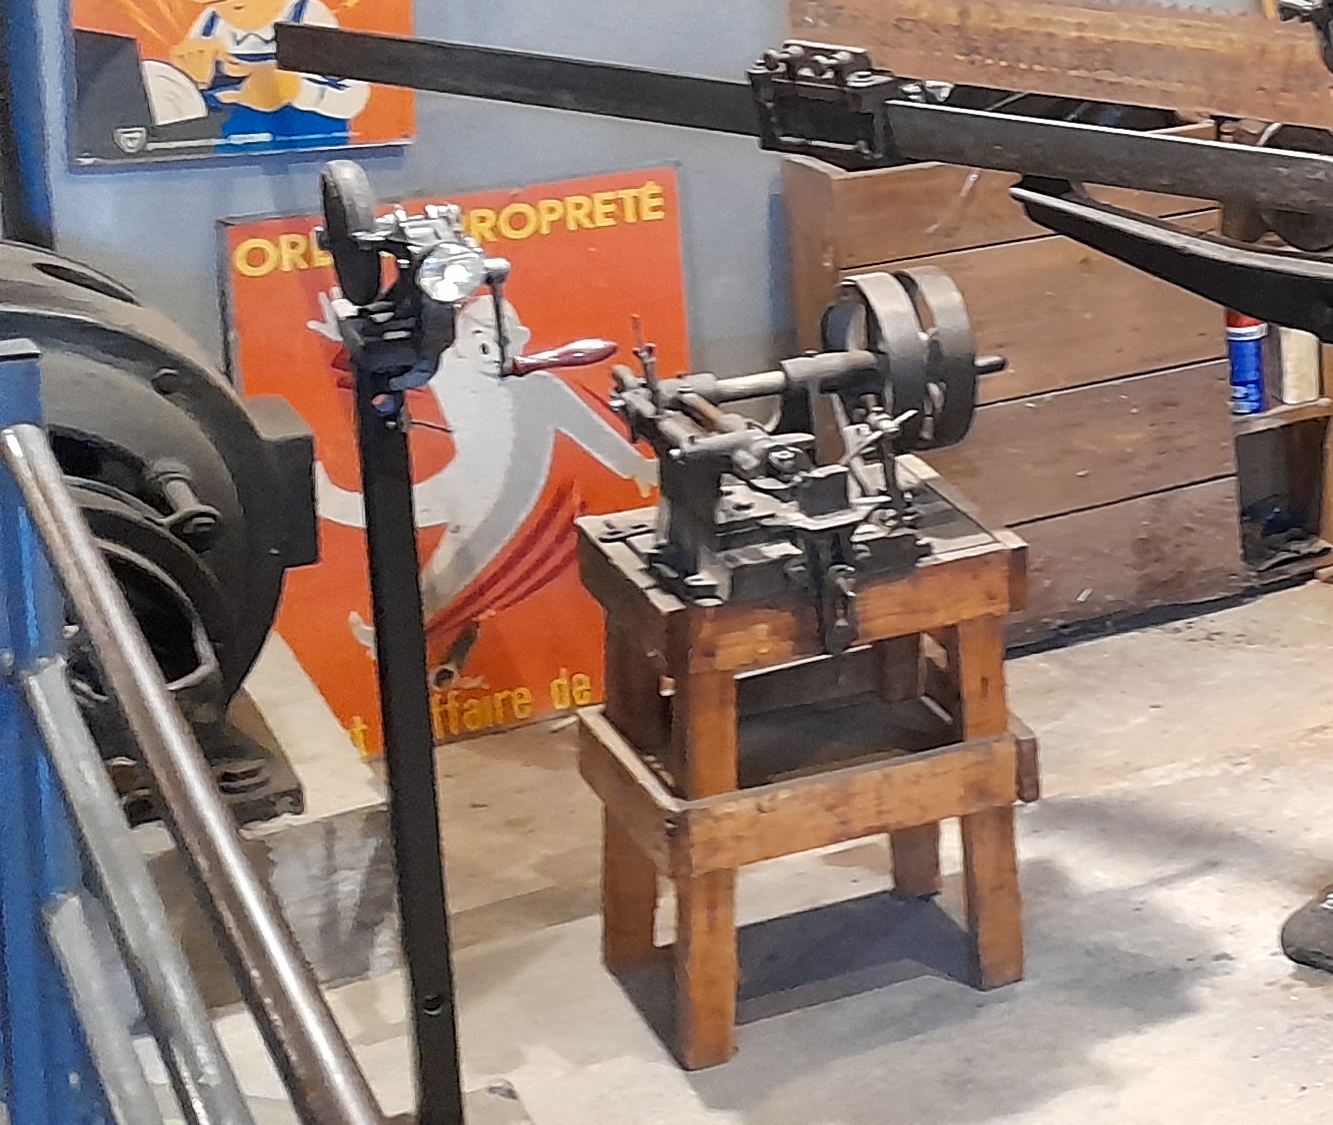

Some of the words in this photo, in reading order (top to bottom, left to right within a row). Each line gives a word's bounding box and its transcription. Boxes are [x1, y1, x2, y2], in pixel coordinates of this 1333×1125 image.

[461, 180, 666, 243] ROPRETÉ
[432, 686, 532, 740] ffaire
[550, 667, 592, 710] de
